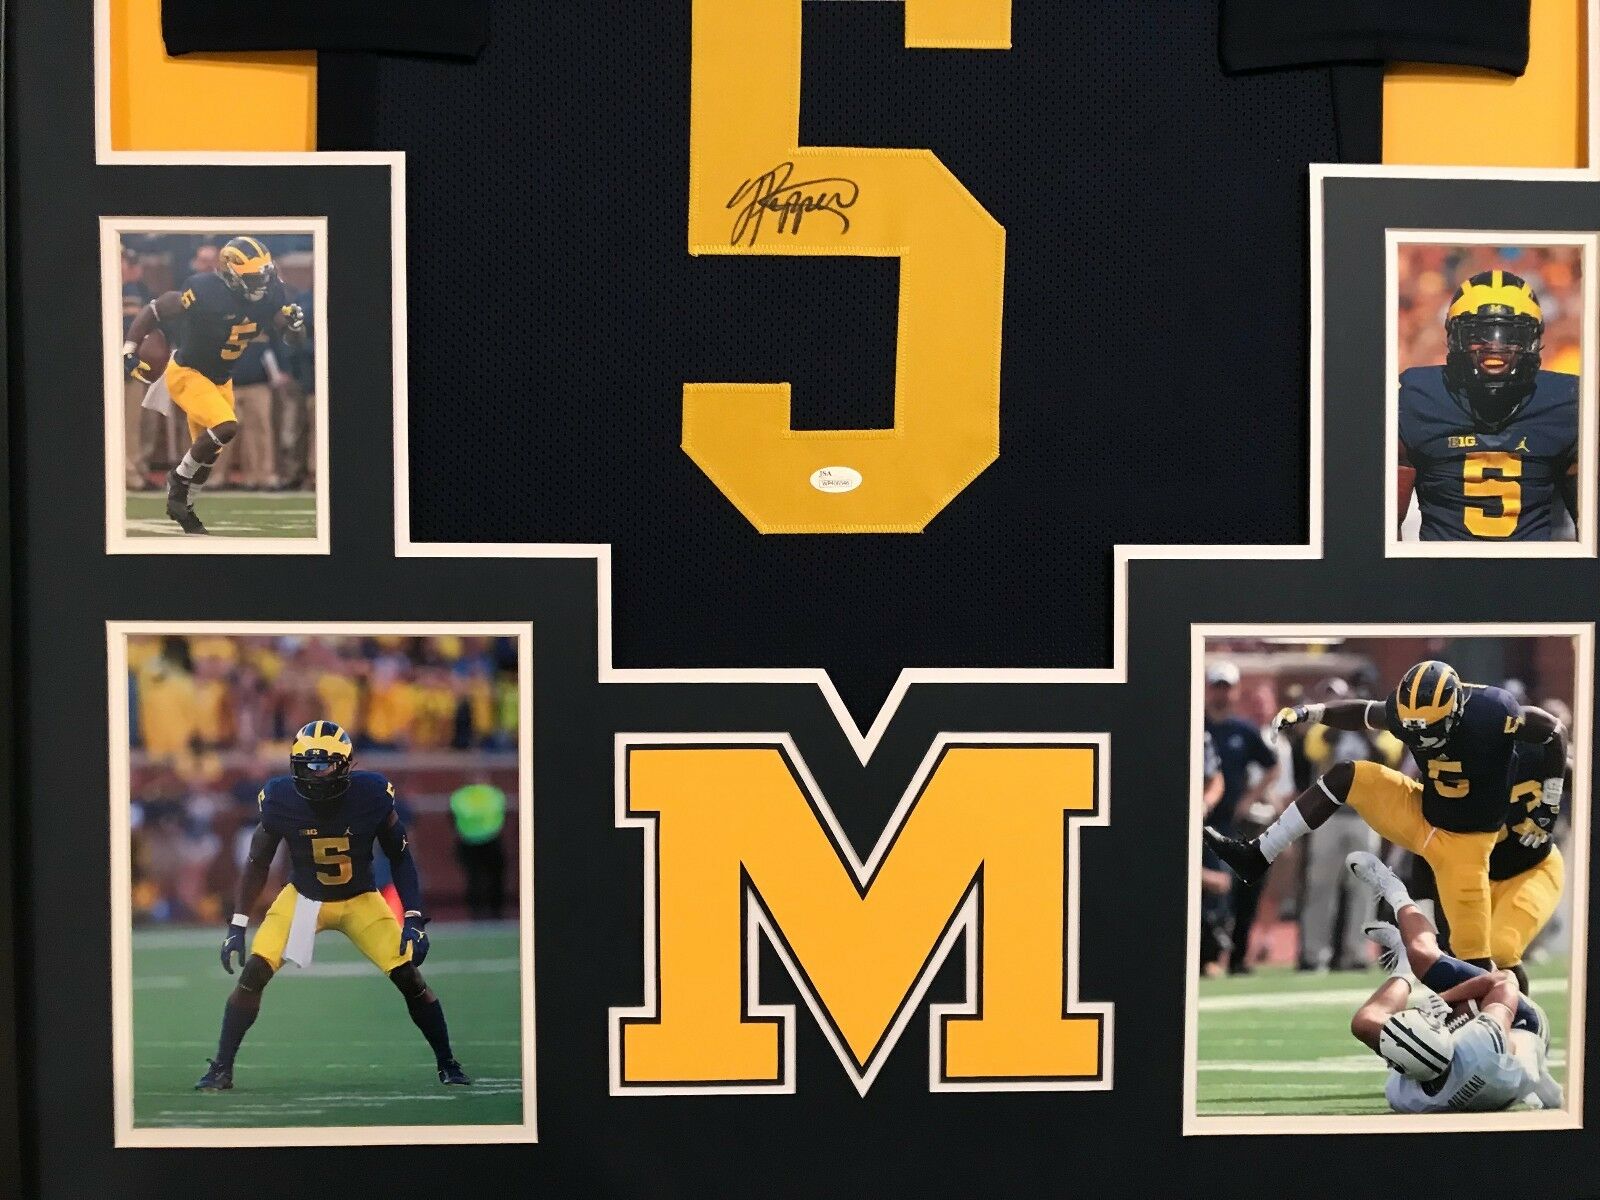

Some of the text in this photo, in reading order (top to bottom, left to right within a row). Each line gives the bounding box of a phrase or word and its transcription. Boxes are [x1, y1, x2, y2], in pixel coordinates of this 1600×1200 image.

[679, 0, 1012, 534] 5
[220, 322, 257, 360] 5
[1463, 451, 1522, 537] 5
[1428, 759, 1470, 799] 5
[312, 837, 353, 886] 5
[608, 731, 1115, 1099] M
